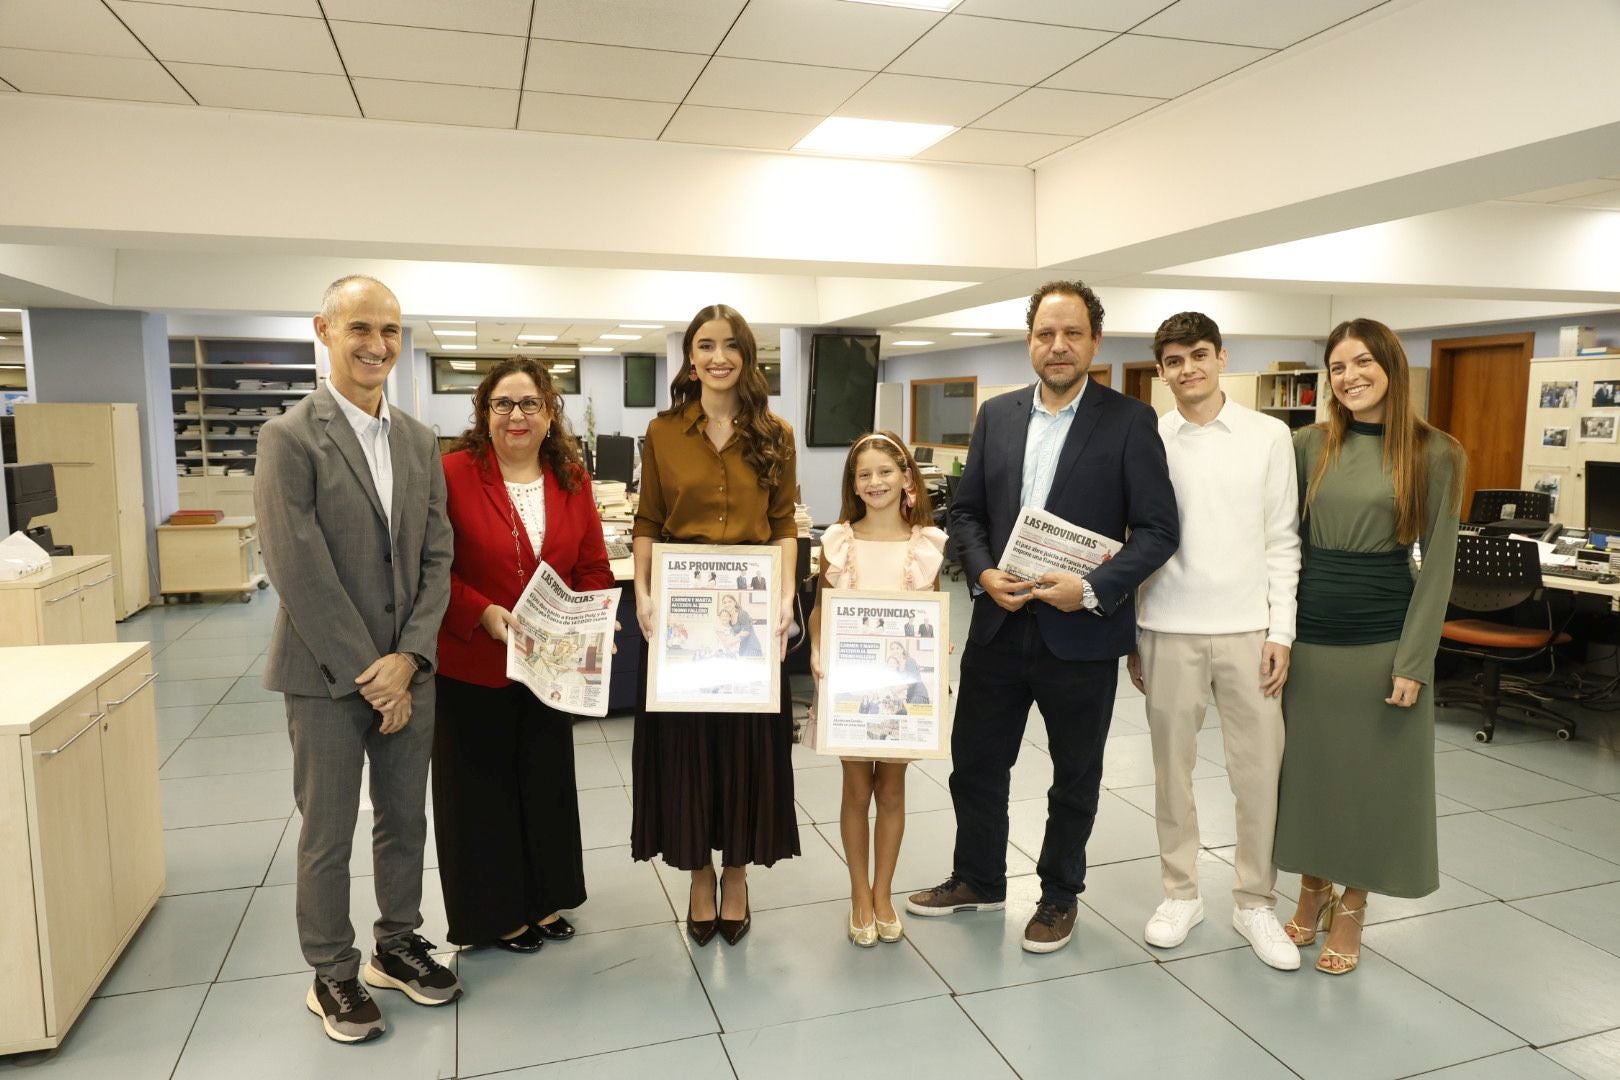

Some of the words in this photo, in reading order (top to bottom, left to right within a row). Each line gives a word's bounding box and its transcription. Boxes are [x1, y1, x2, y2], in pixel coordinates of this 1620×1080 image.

[1024, 515, 1042, 529] LAS
[1041, 522, 1098, 550] PROVINCIAS
[668, 561, 687, 570] LAS
[689, 561, 749, 571] PROVINCIAS
[541, 570, 552, 586] LAS
[551, 581, 595, 603] PROVINCIAS
[837, 606, 856, 616] LAS
[857, 607, 916, 618] PROVINCIAS
